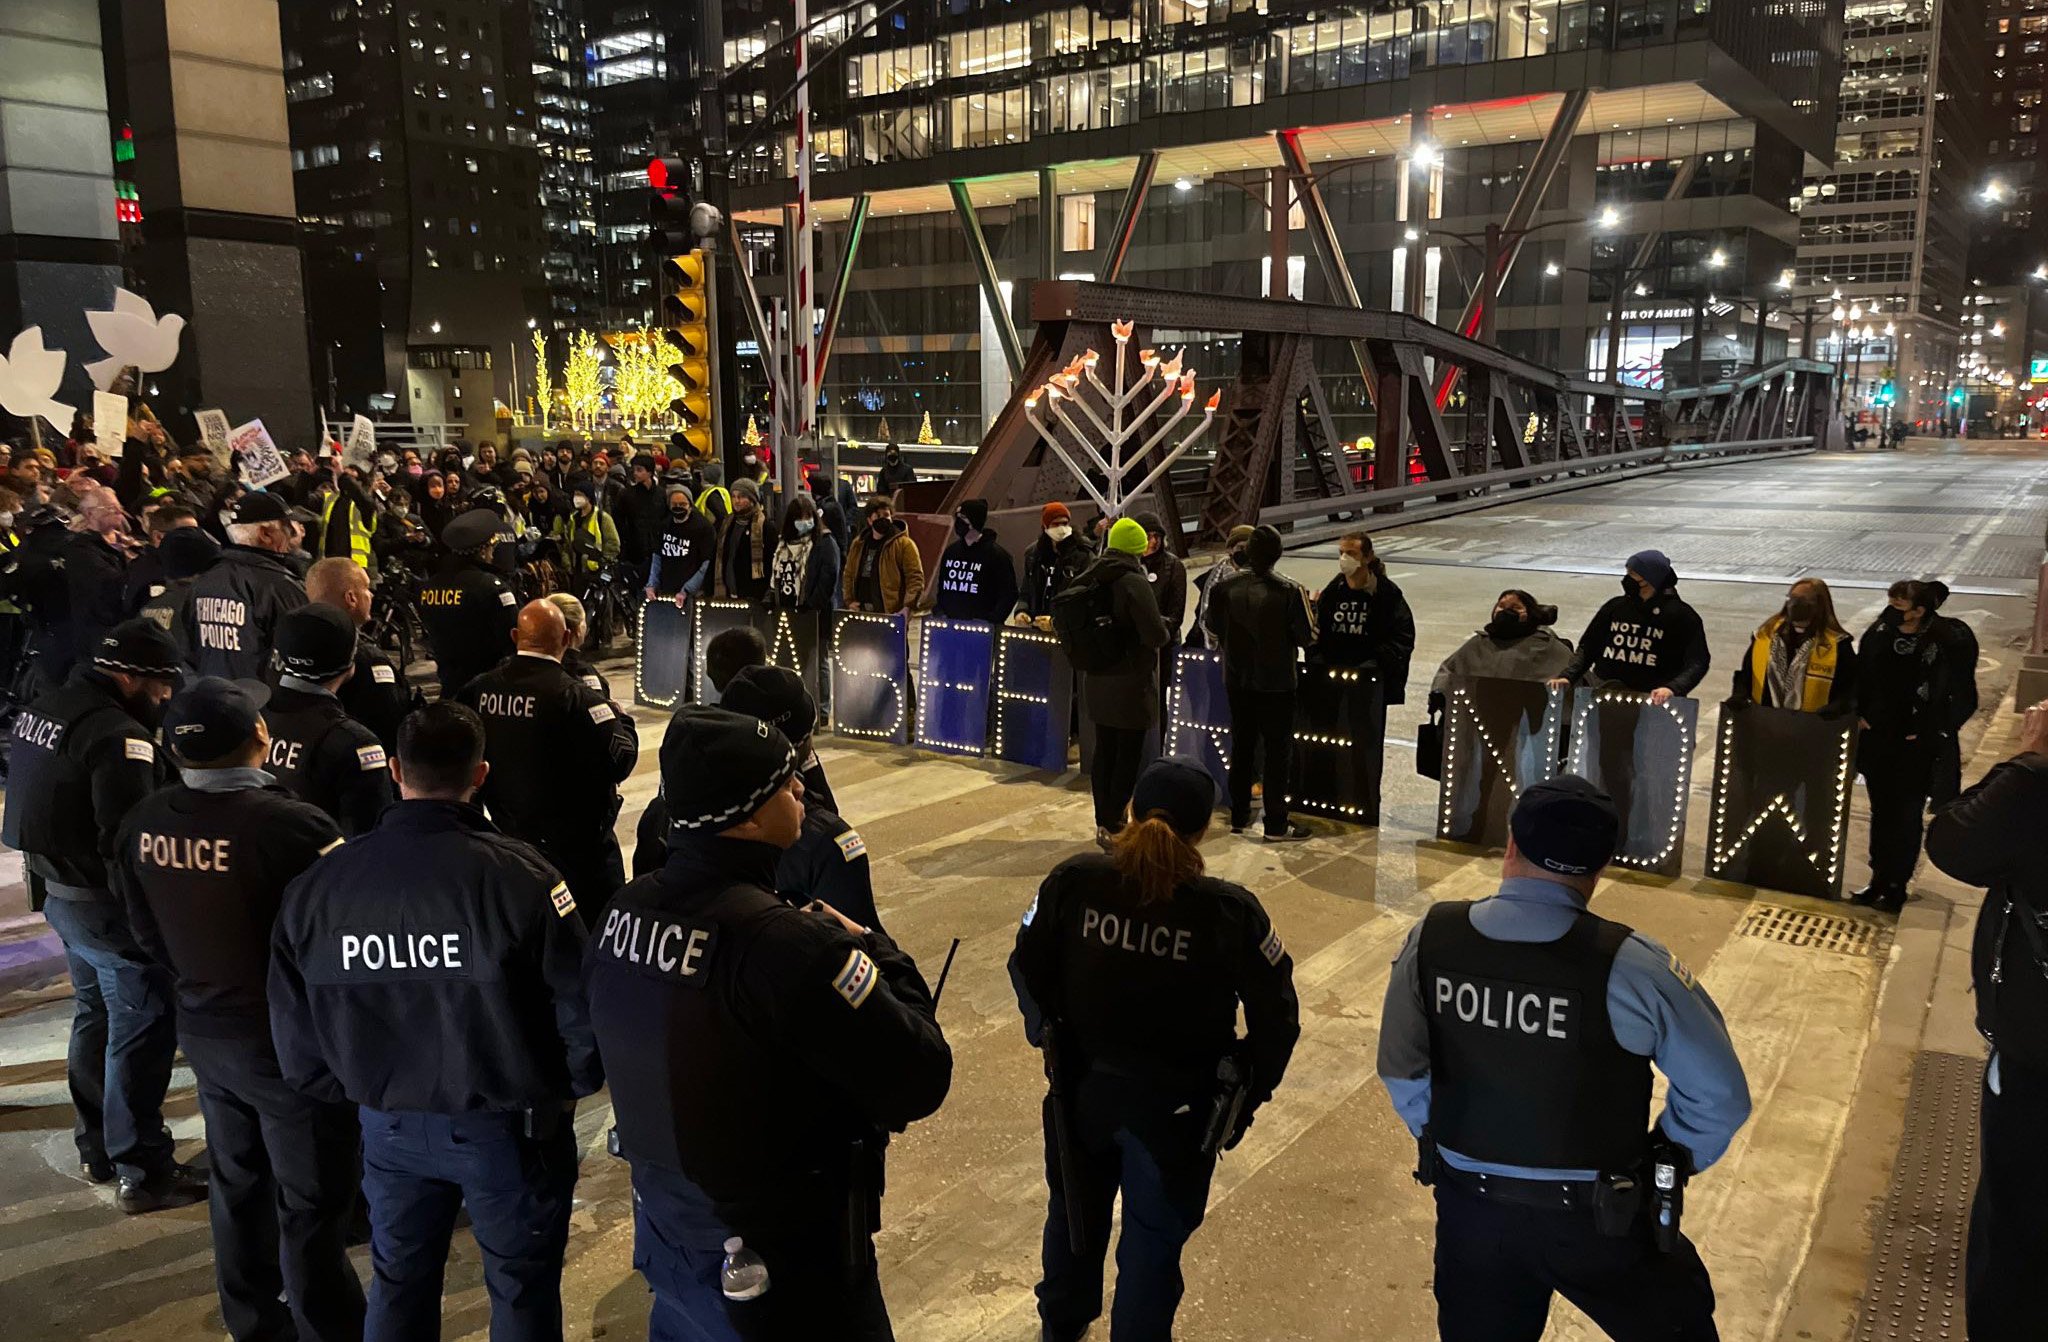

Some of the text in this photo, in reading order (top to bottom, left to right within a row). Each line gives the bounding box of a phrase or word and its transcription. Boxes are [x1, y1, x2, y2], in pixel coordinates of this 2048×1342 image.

[1639, 310, 1653, 319] OF
[946, 559, 981, 571] NOT IN
[948, 570, 974, 581] OUR
[420, 589, 463, 606] POLICE
[943, 580, 978, 593] NAME
[196, 597, 245, 626] CHICAGO
[200, 623, 242, 651] POLICE
[1610, 621, 1664, 639] NOT IN
[1613, 634, 1652, 651] OUR
[1602, 646, 1657, 666] NAME
[478, 692, 535, 718] POLICE
[12, 711, 64, 750] POLICE
[138, 832, 230, 872] POLICE
[599, 908, 710, 976] POLICE
[1083, 907, 1191, 961] POLICE
[341, 934, 462, 970] POLICE
[1436, 976, 1569, 1039] POLICE
